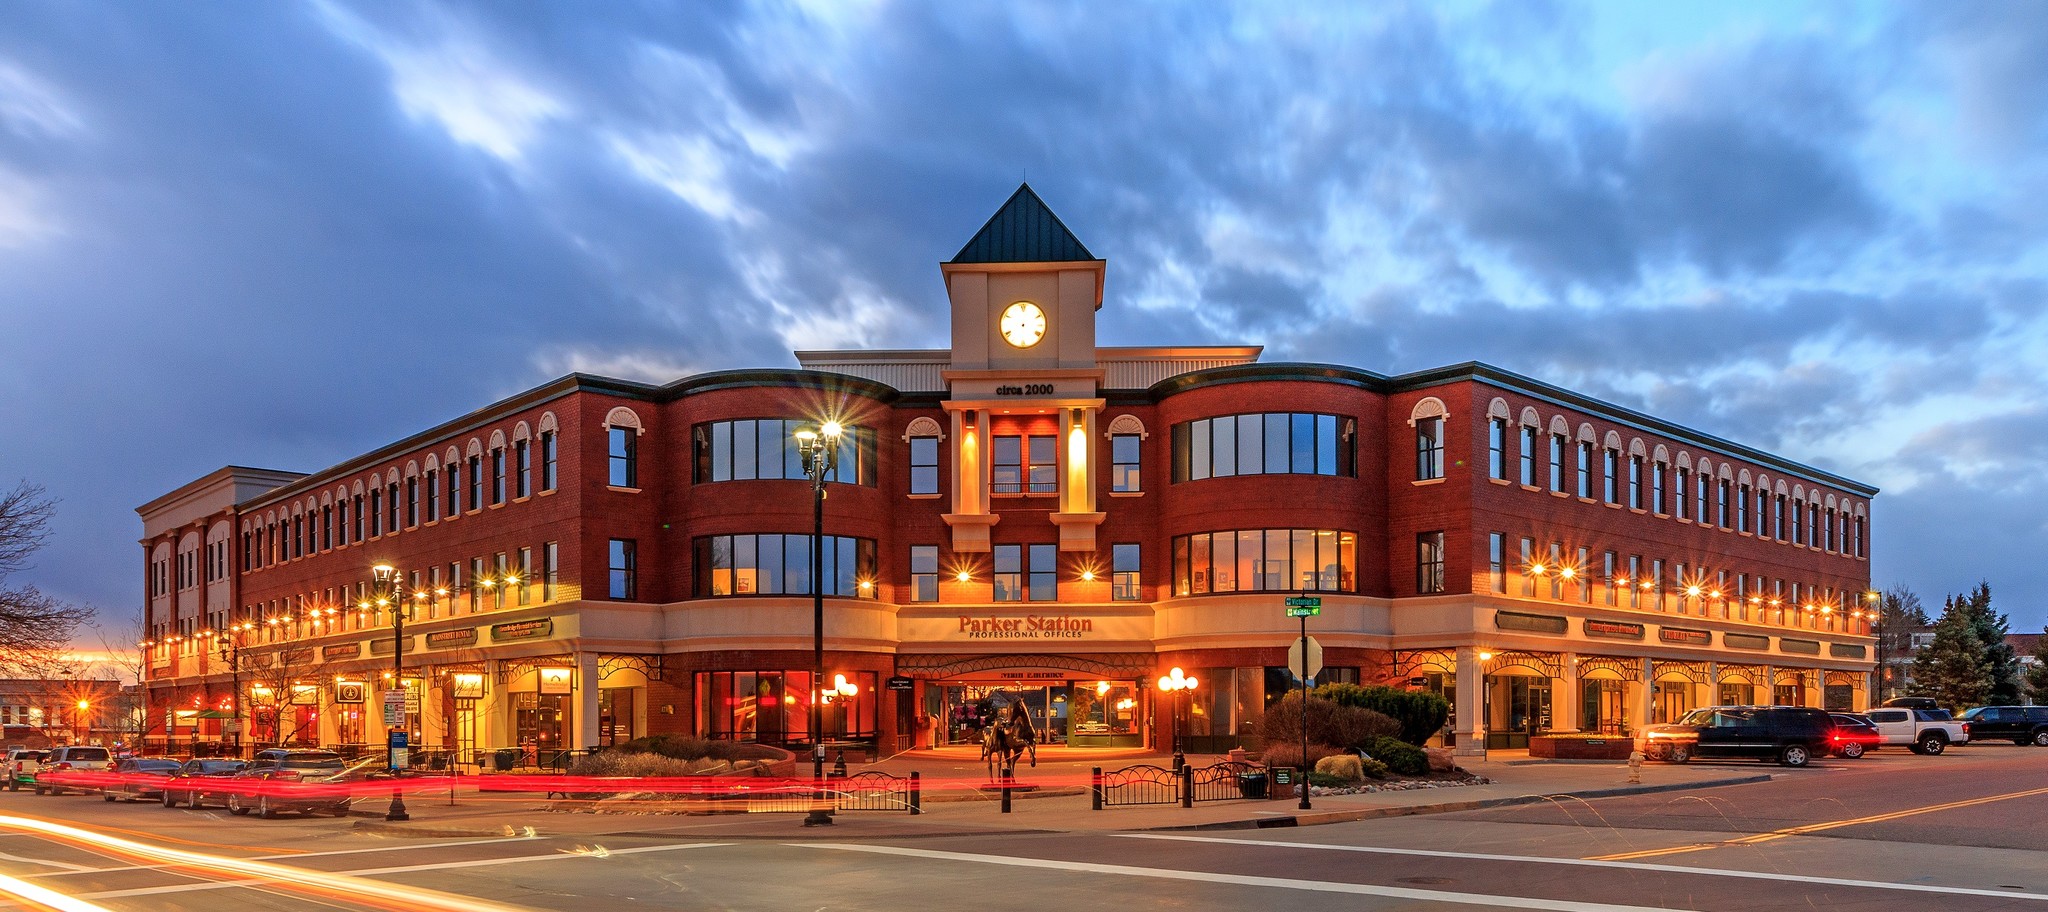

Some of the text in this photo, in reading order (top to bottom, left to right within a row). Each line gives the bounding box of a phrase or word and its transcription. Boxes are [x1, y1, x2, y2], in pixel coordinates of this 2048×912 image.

[996, 384, 1054, 395] circa 2000
[959, 614, 1092, 632] Parker Station
